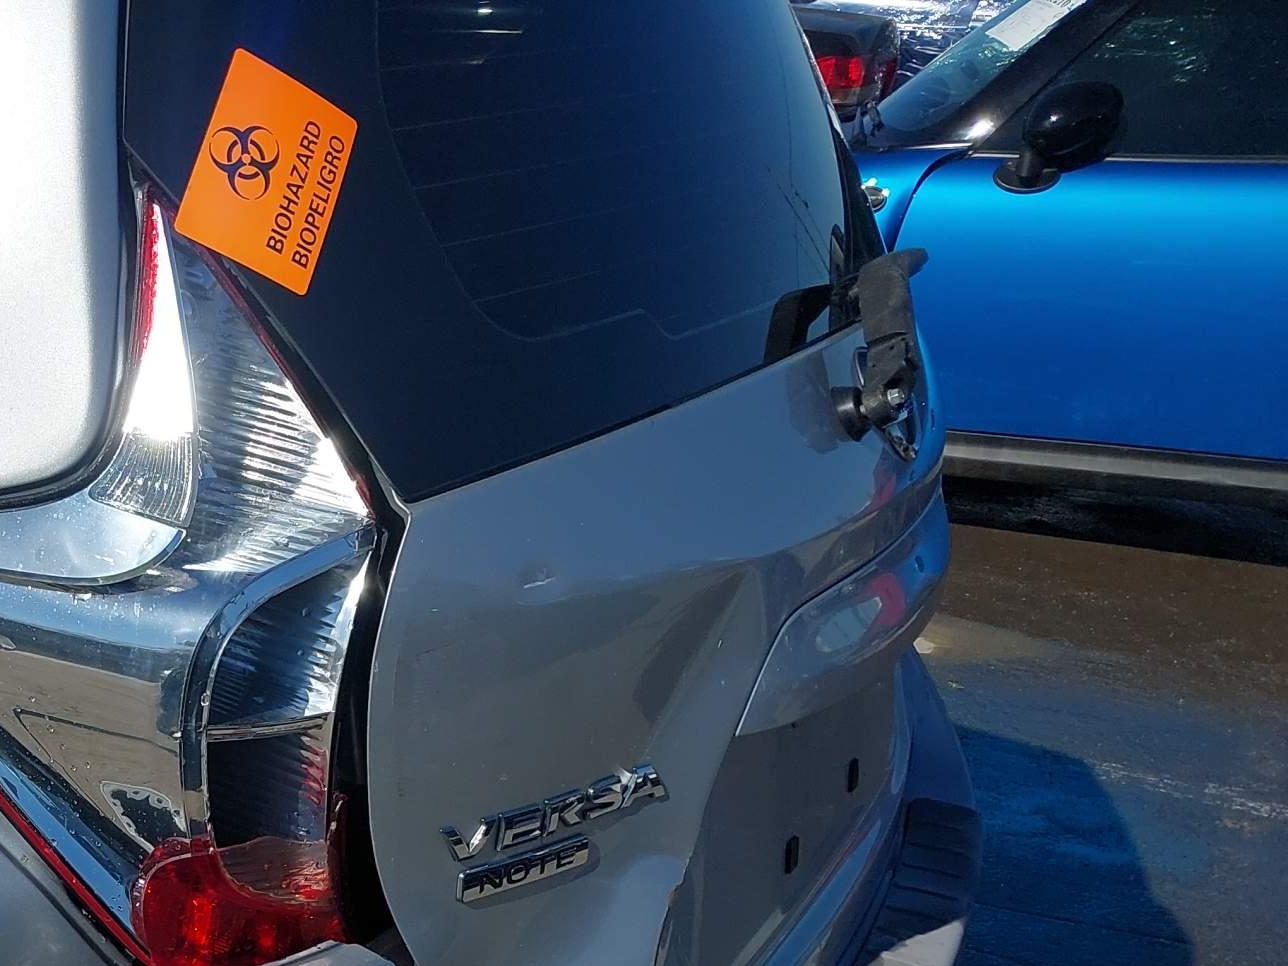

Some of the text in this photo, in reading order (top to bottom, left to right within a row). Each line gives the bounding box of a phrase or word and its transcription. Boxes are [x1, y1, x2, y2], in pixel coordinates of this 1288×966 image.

[265, 121, 321, 255] BIOHAZARD
[291, 135, 345, 269] BIOPELIGRO
[440, 764, 668, 861] VERSA
[479, 848, 578, 894] NOTE
